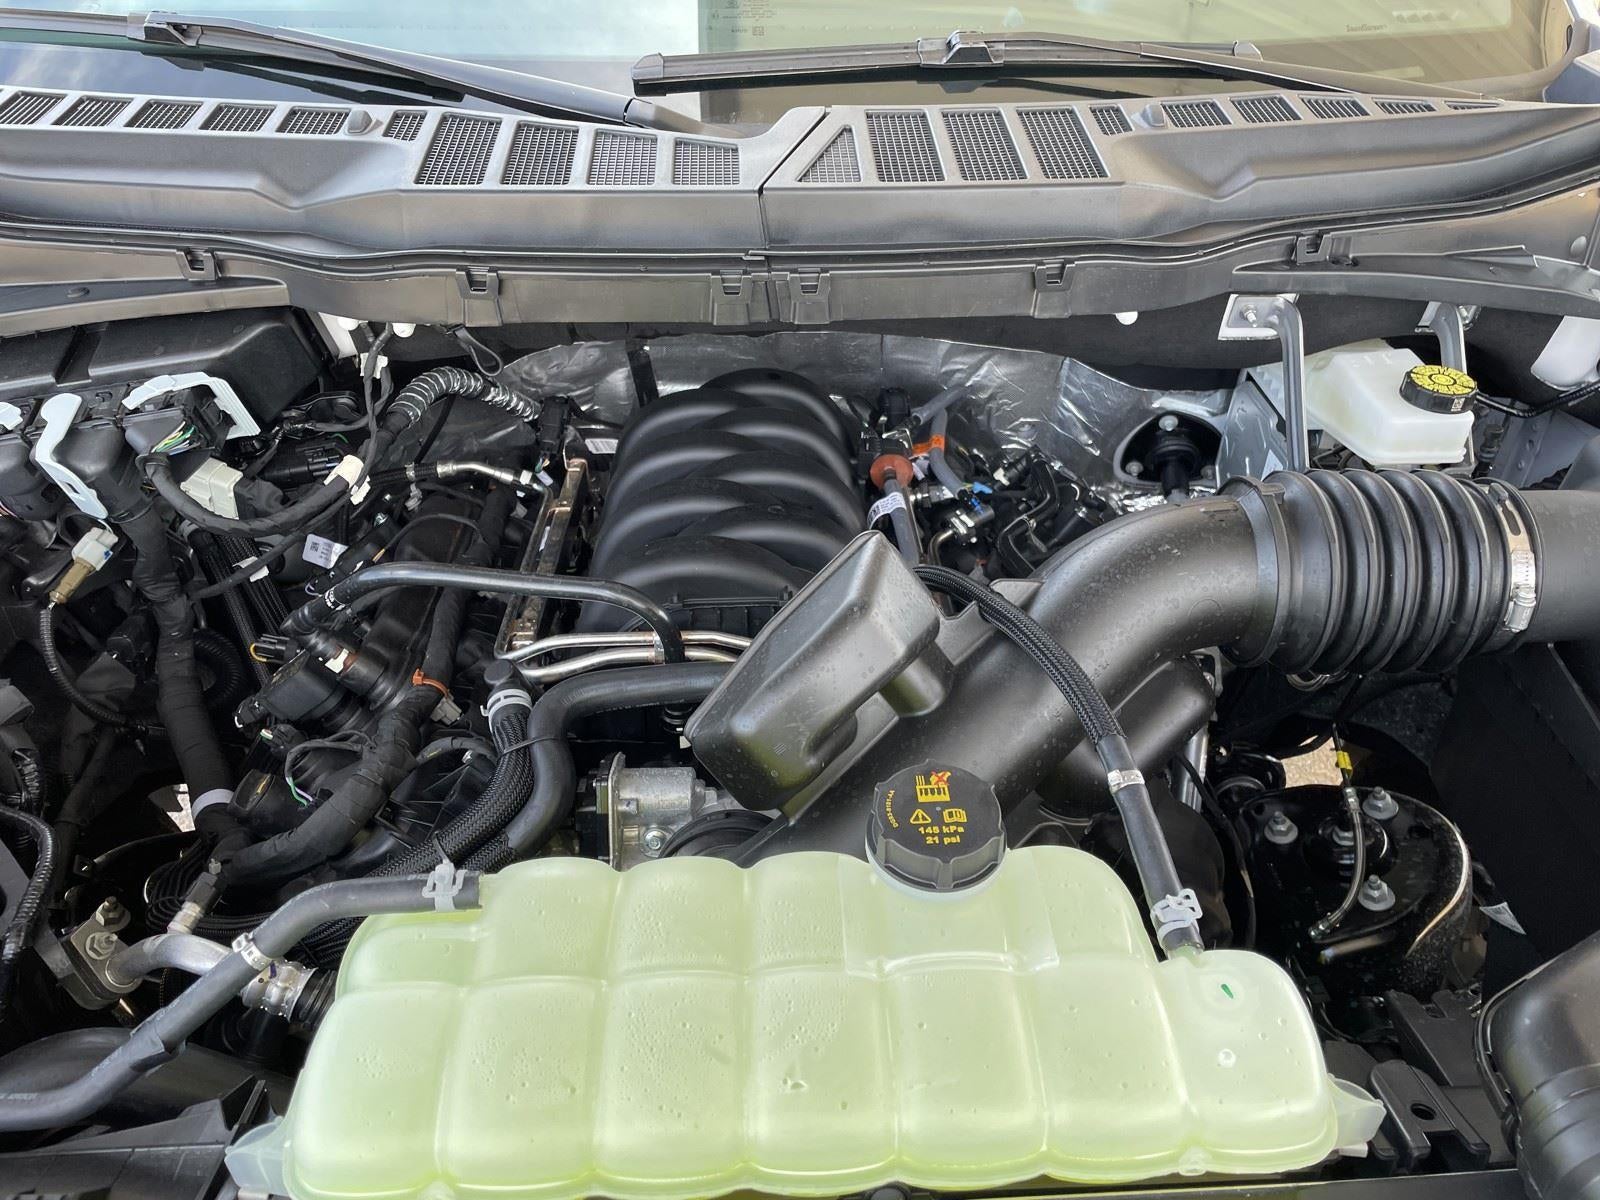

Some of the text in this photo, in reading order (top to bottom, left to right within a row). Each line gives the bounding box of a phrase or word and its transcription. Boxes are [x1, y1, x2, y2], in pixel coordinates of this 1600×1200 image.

[918, 825, 965, 834] 145 kPa
[926, 835, 961, 845] 21 psi
